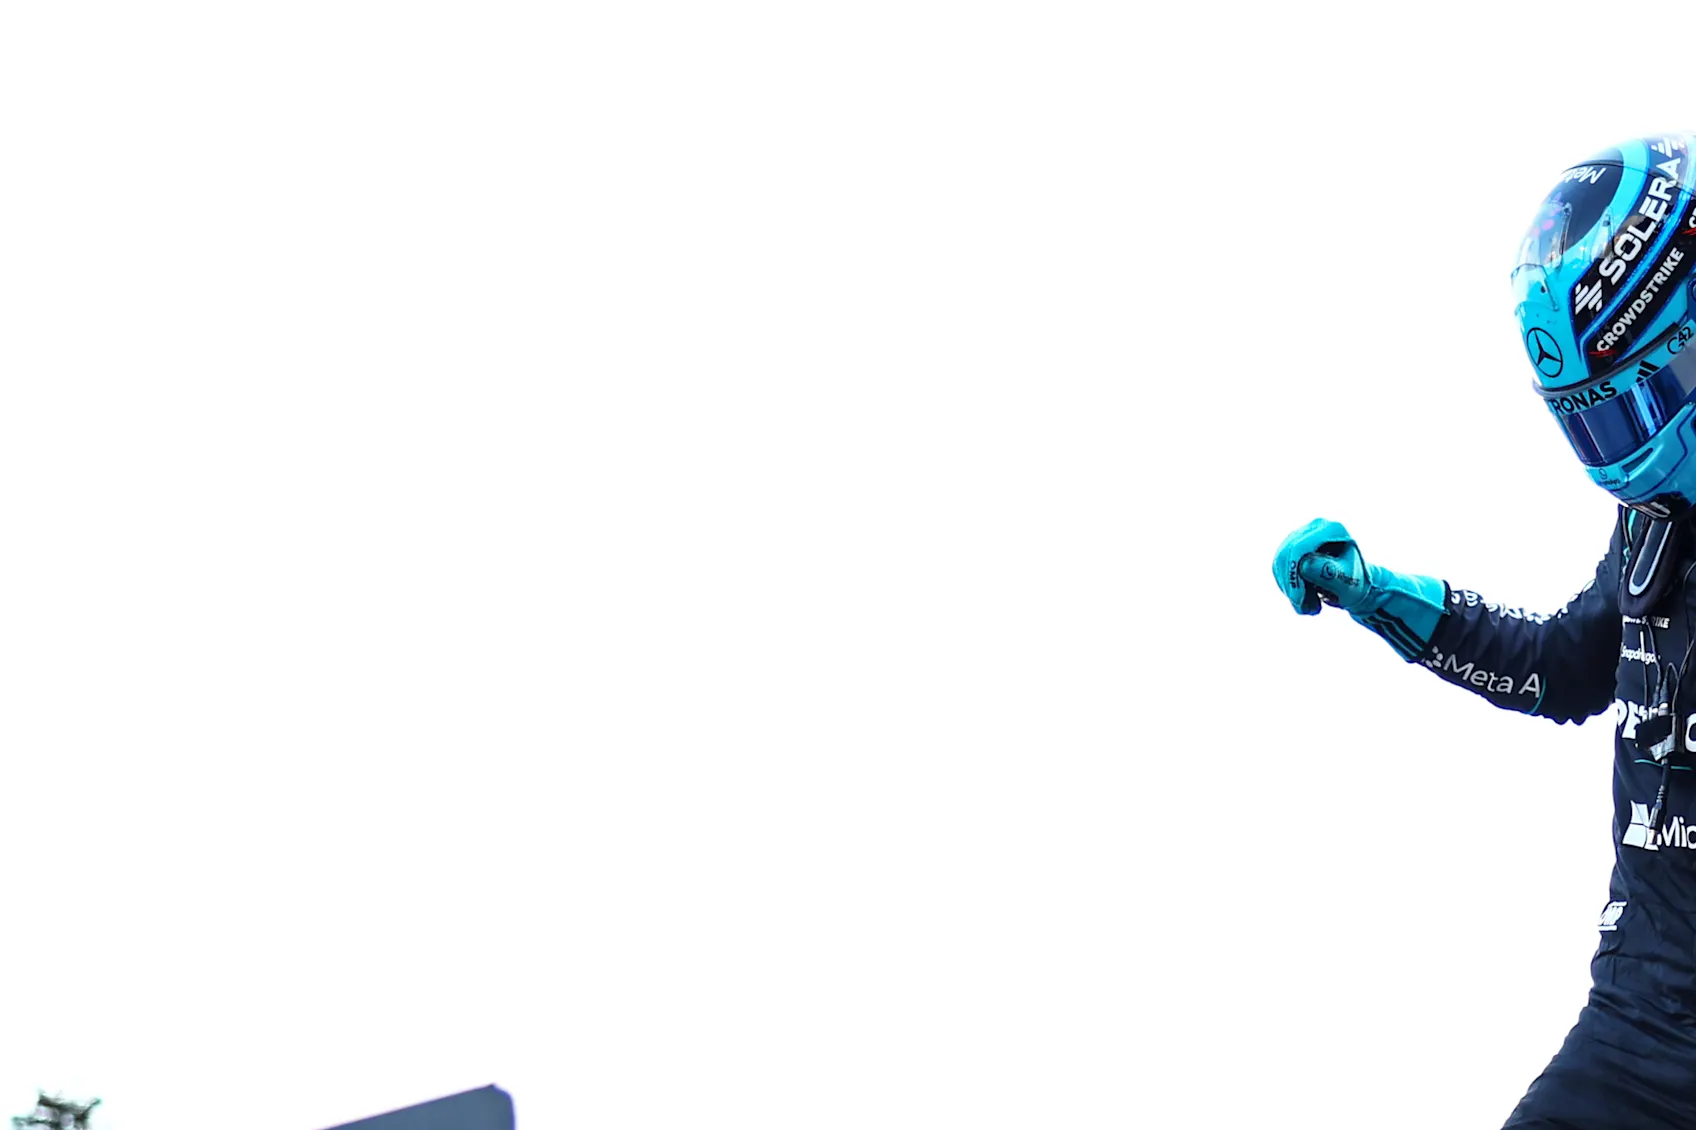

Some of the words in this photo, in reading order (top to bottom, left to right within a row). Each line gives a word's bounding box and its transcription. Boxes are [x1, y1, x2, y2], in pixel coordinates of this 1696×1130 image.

[1599, 157, 1681, 286] SOLERA
[1596, 247, 1685, 353] CROWDSTRIKE
[1443, 653, 1514, 694] Meta
